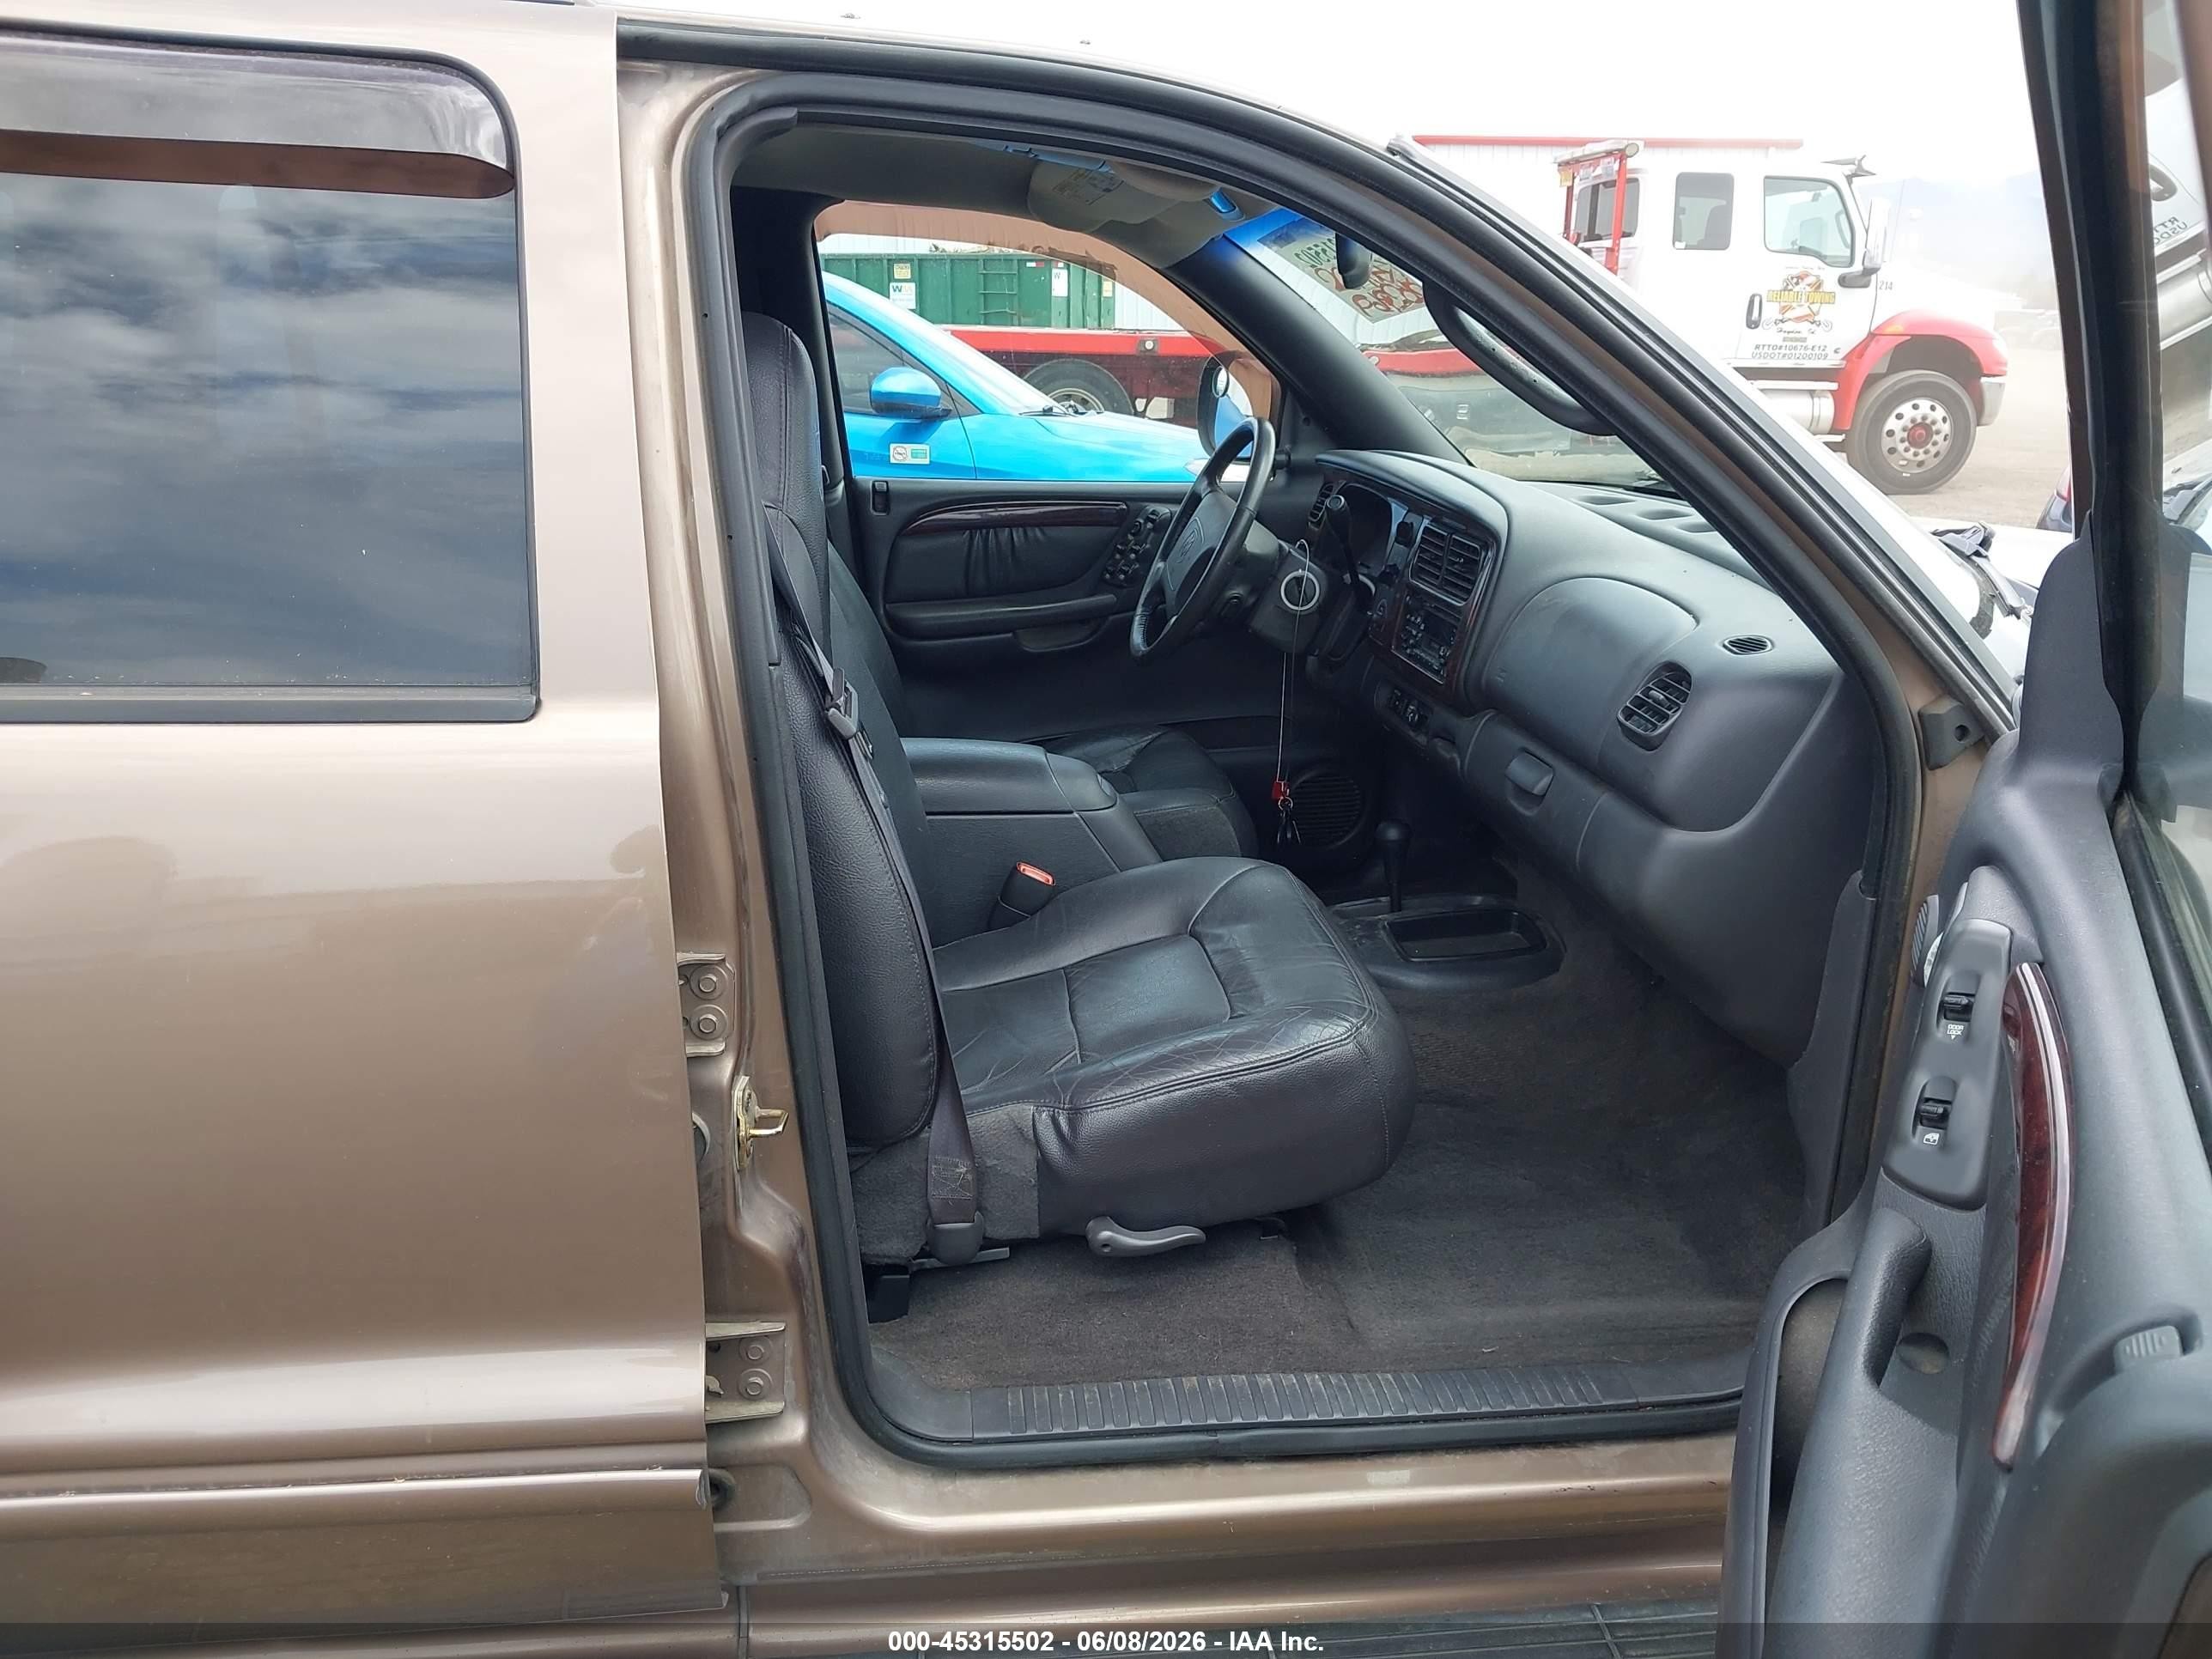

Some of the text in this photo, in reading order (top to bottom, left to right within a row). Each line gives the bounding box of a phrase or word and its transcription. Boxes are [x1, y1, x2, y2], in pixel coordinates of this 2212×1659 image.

[1879, 280, 1893, 290] 214
[1766, 289, 1836, 304] RELIABLE TOWING
